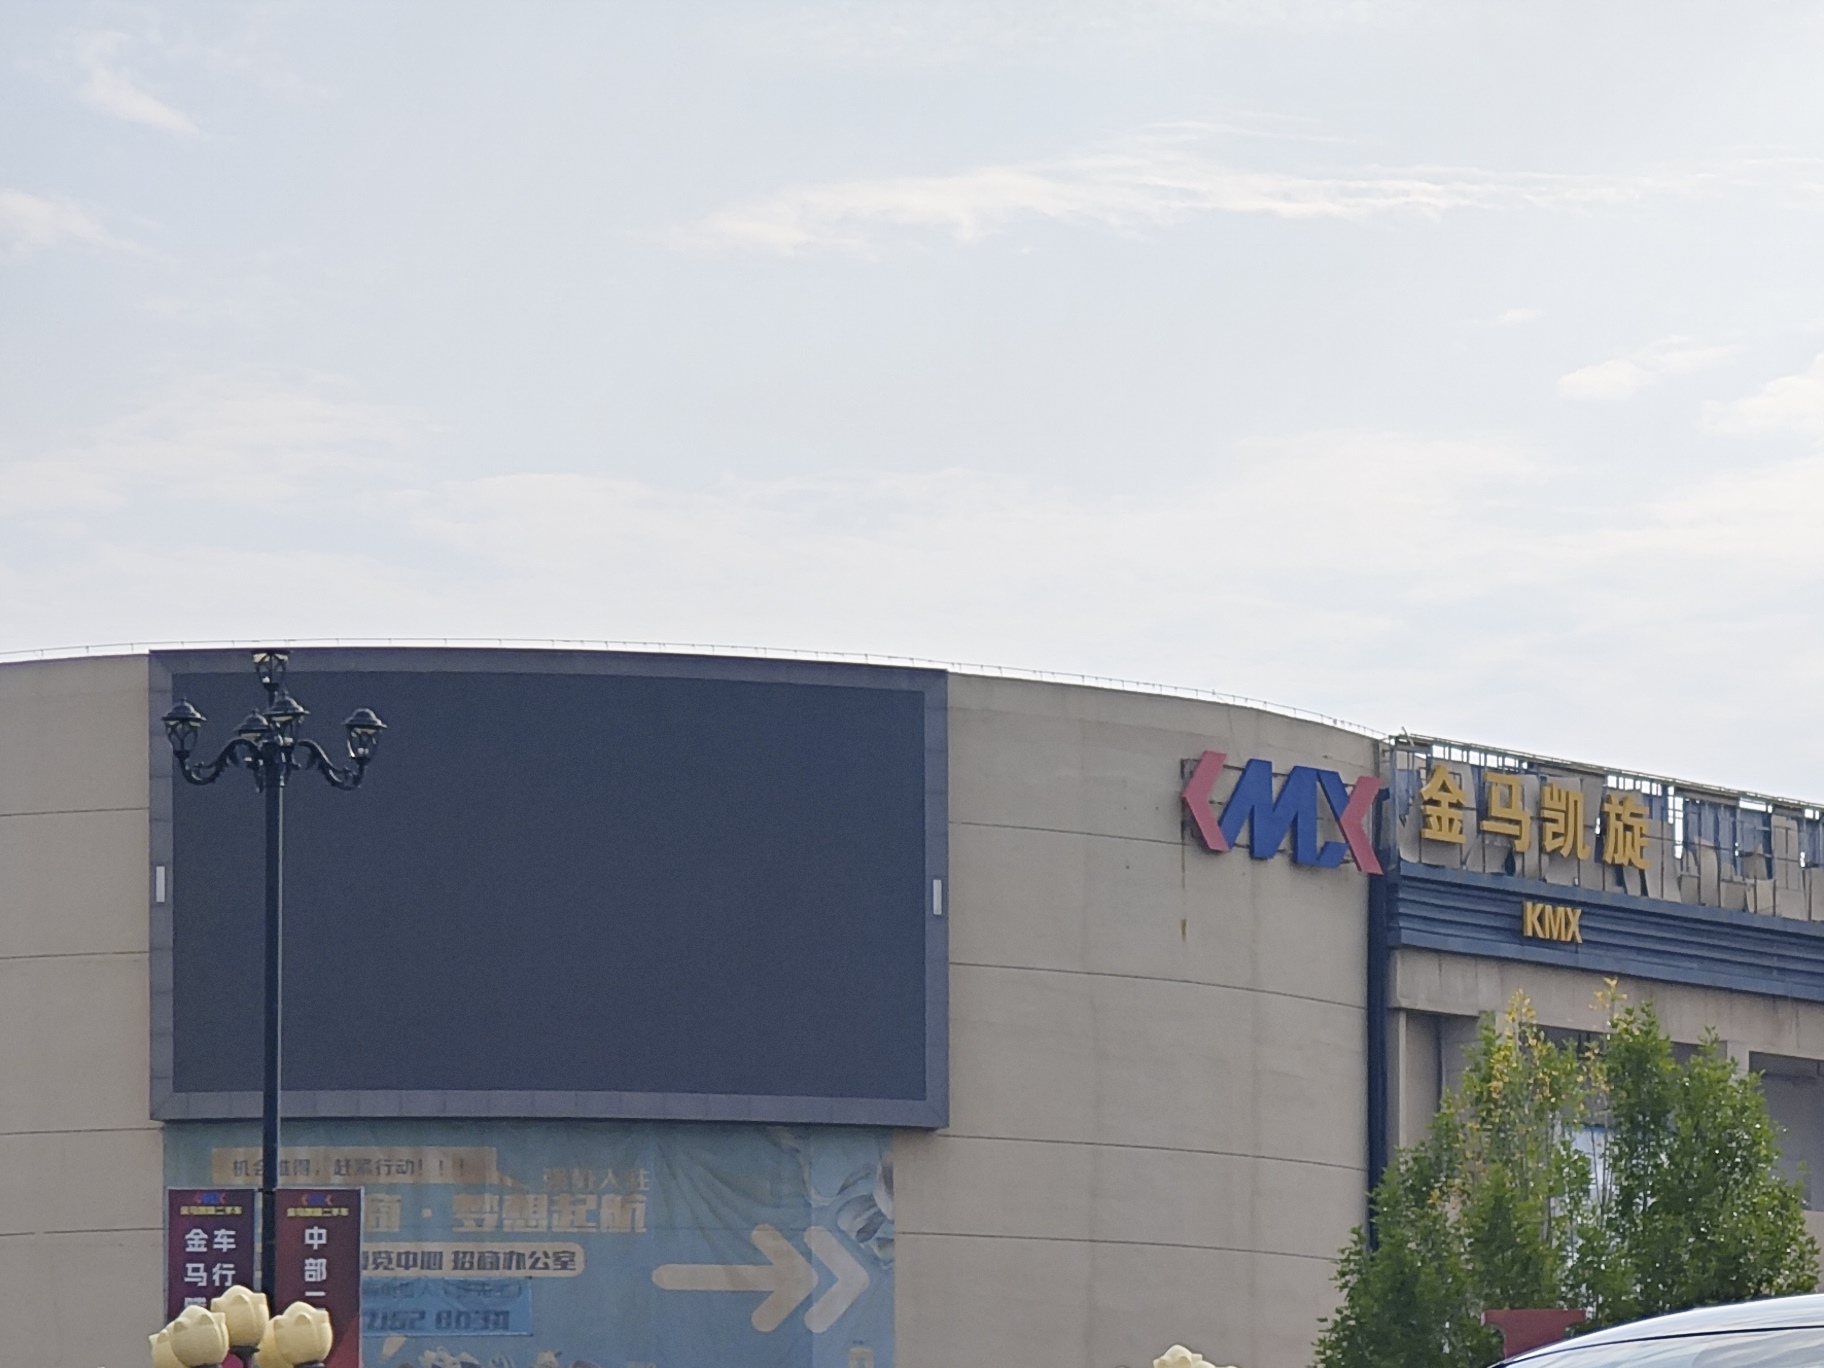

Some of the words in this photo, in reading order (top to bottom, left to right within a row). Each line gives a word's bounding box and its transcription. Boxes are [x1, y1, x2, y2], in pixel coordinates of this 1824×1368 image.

[1419, 765, 1650, 869] 金马凯旋
[1523, 901, 1583, 944] KMX
[362, 1250, 443, 1271] 览中心
[452, 1250, 577, 1271] 招商办公室
